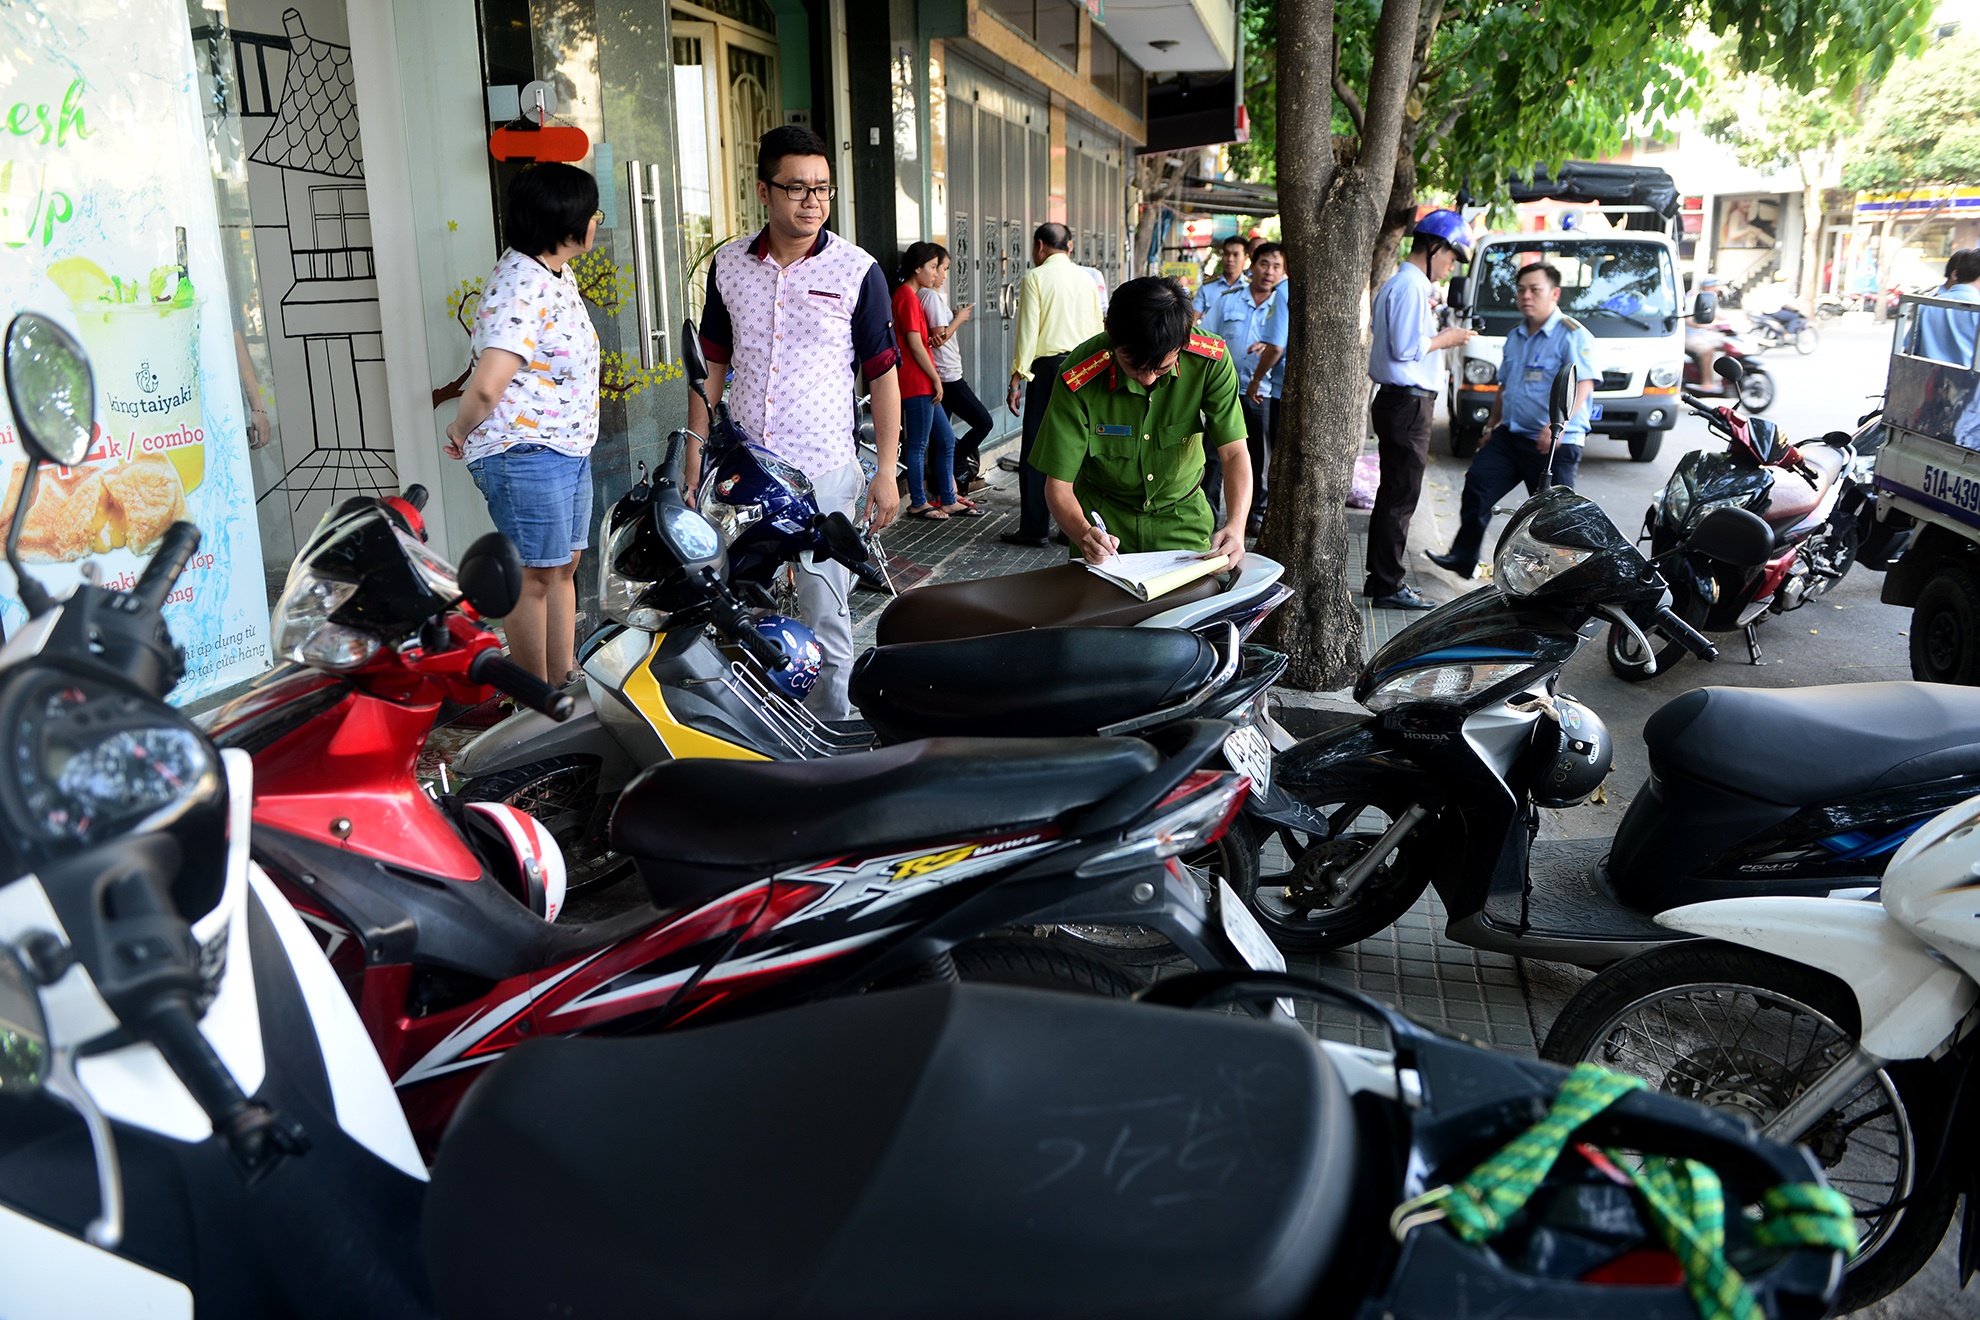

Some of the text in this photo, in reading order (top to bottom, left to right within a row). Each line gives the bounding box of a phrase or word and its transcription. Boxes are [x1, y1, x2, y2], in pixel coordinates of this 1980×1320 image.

[0, 77, 97, 148] esh
[142, 423, 204, 451] combo
[1923, 464, 1980, 513] 51A-439
[161, 586, 193, 606] ong
[214, 634, 243, 650] dụng
[238, 644, 266, 662] hàng
[1403, 731, 1450, 741] HONDA
